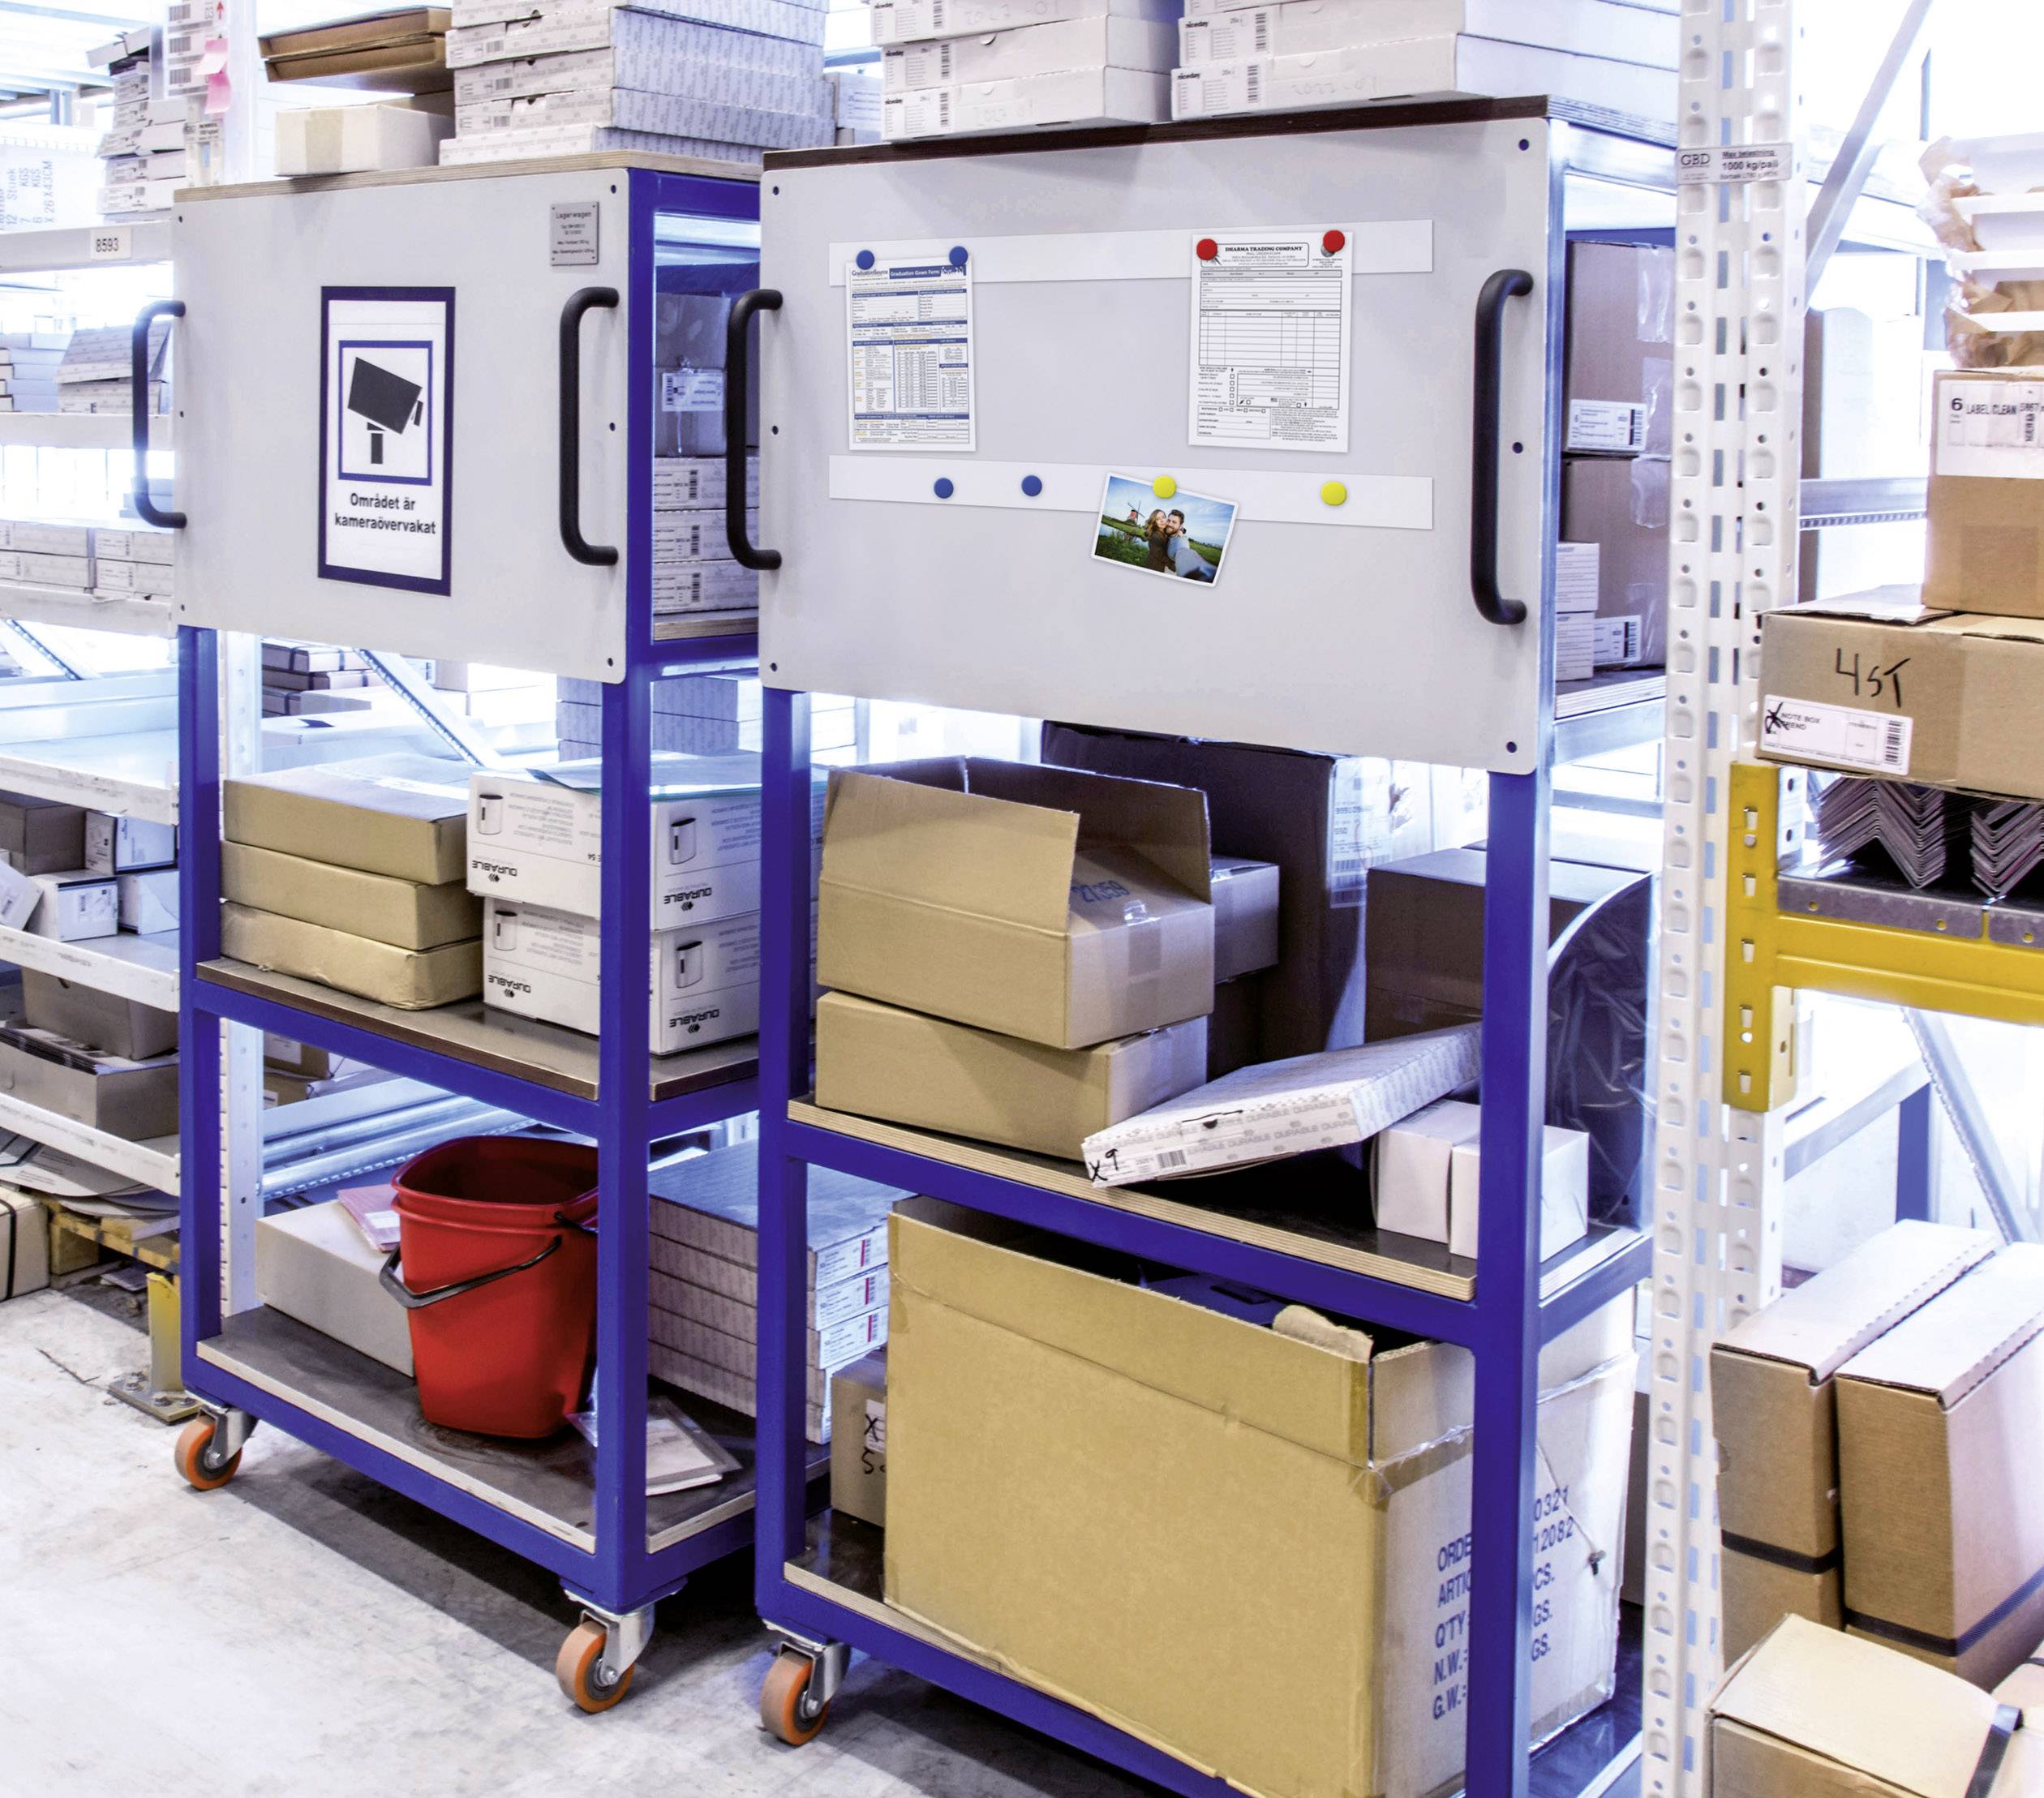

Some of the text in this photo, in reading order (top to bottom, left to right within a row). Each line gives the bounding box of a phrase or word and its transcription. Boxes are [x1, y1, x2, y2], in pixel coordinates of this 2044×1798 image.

[1185, 20, 1209, 28] niceday
[1681, 153, 1711, 165] GBD
[1722, 161, 1744, 170] 1000
[96, 238, 118, 252] 8593
[1952, 397, 1963, 411] 6
[1966, 404, 1990, 414] LABEL
[1992, 404, 2016, 415] CLEAN
[350, 492, 416, 511] Området är
[334, 513, 436, 534] kameraövervakat
[472, 860, 517, 877] DURABLE
[663, 886, 712, 905] DURABLE
[487, 974, 531, 993] DURABLE
[669, 1008, 719, 1028] DURABLE
[1228, 1132, 1272, 1148] DURABLE
[1274, 1125, 1318, 1139] DURABLE
[1533, 1515, 1574, 1554] 12082
[1534, 1562, 1555, 1590] CS.
[1533, 1599, 1553, 1627] GS.
[1531, 1633, 1551, 1662] GS.
